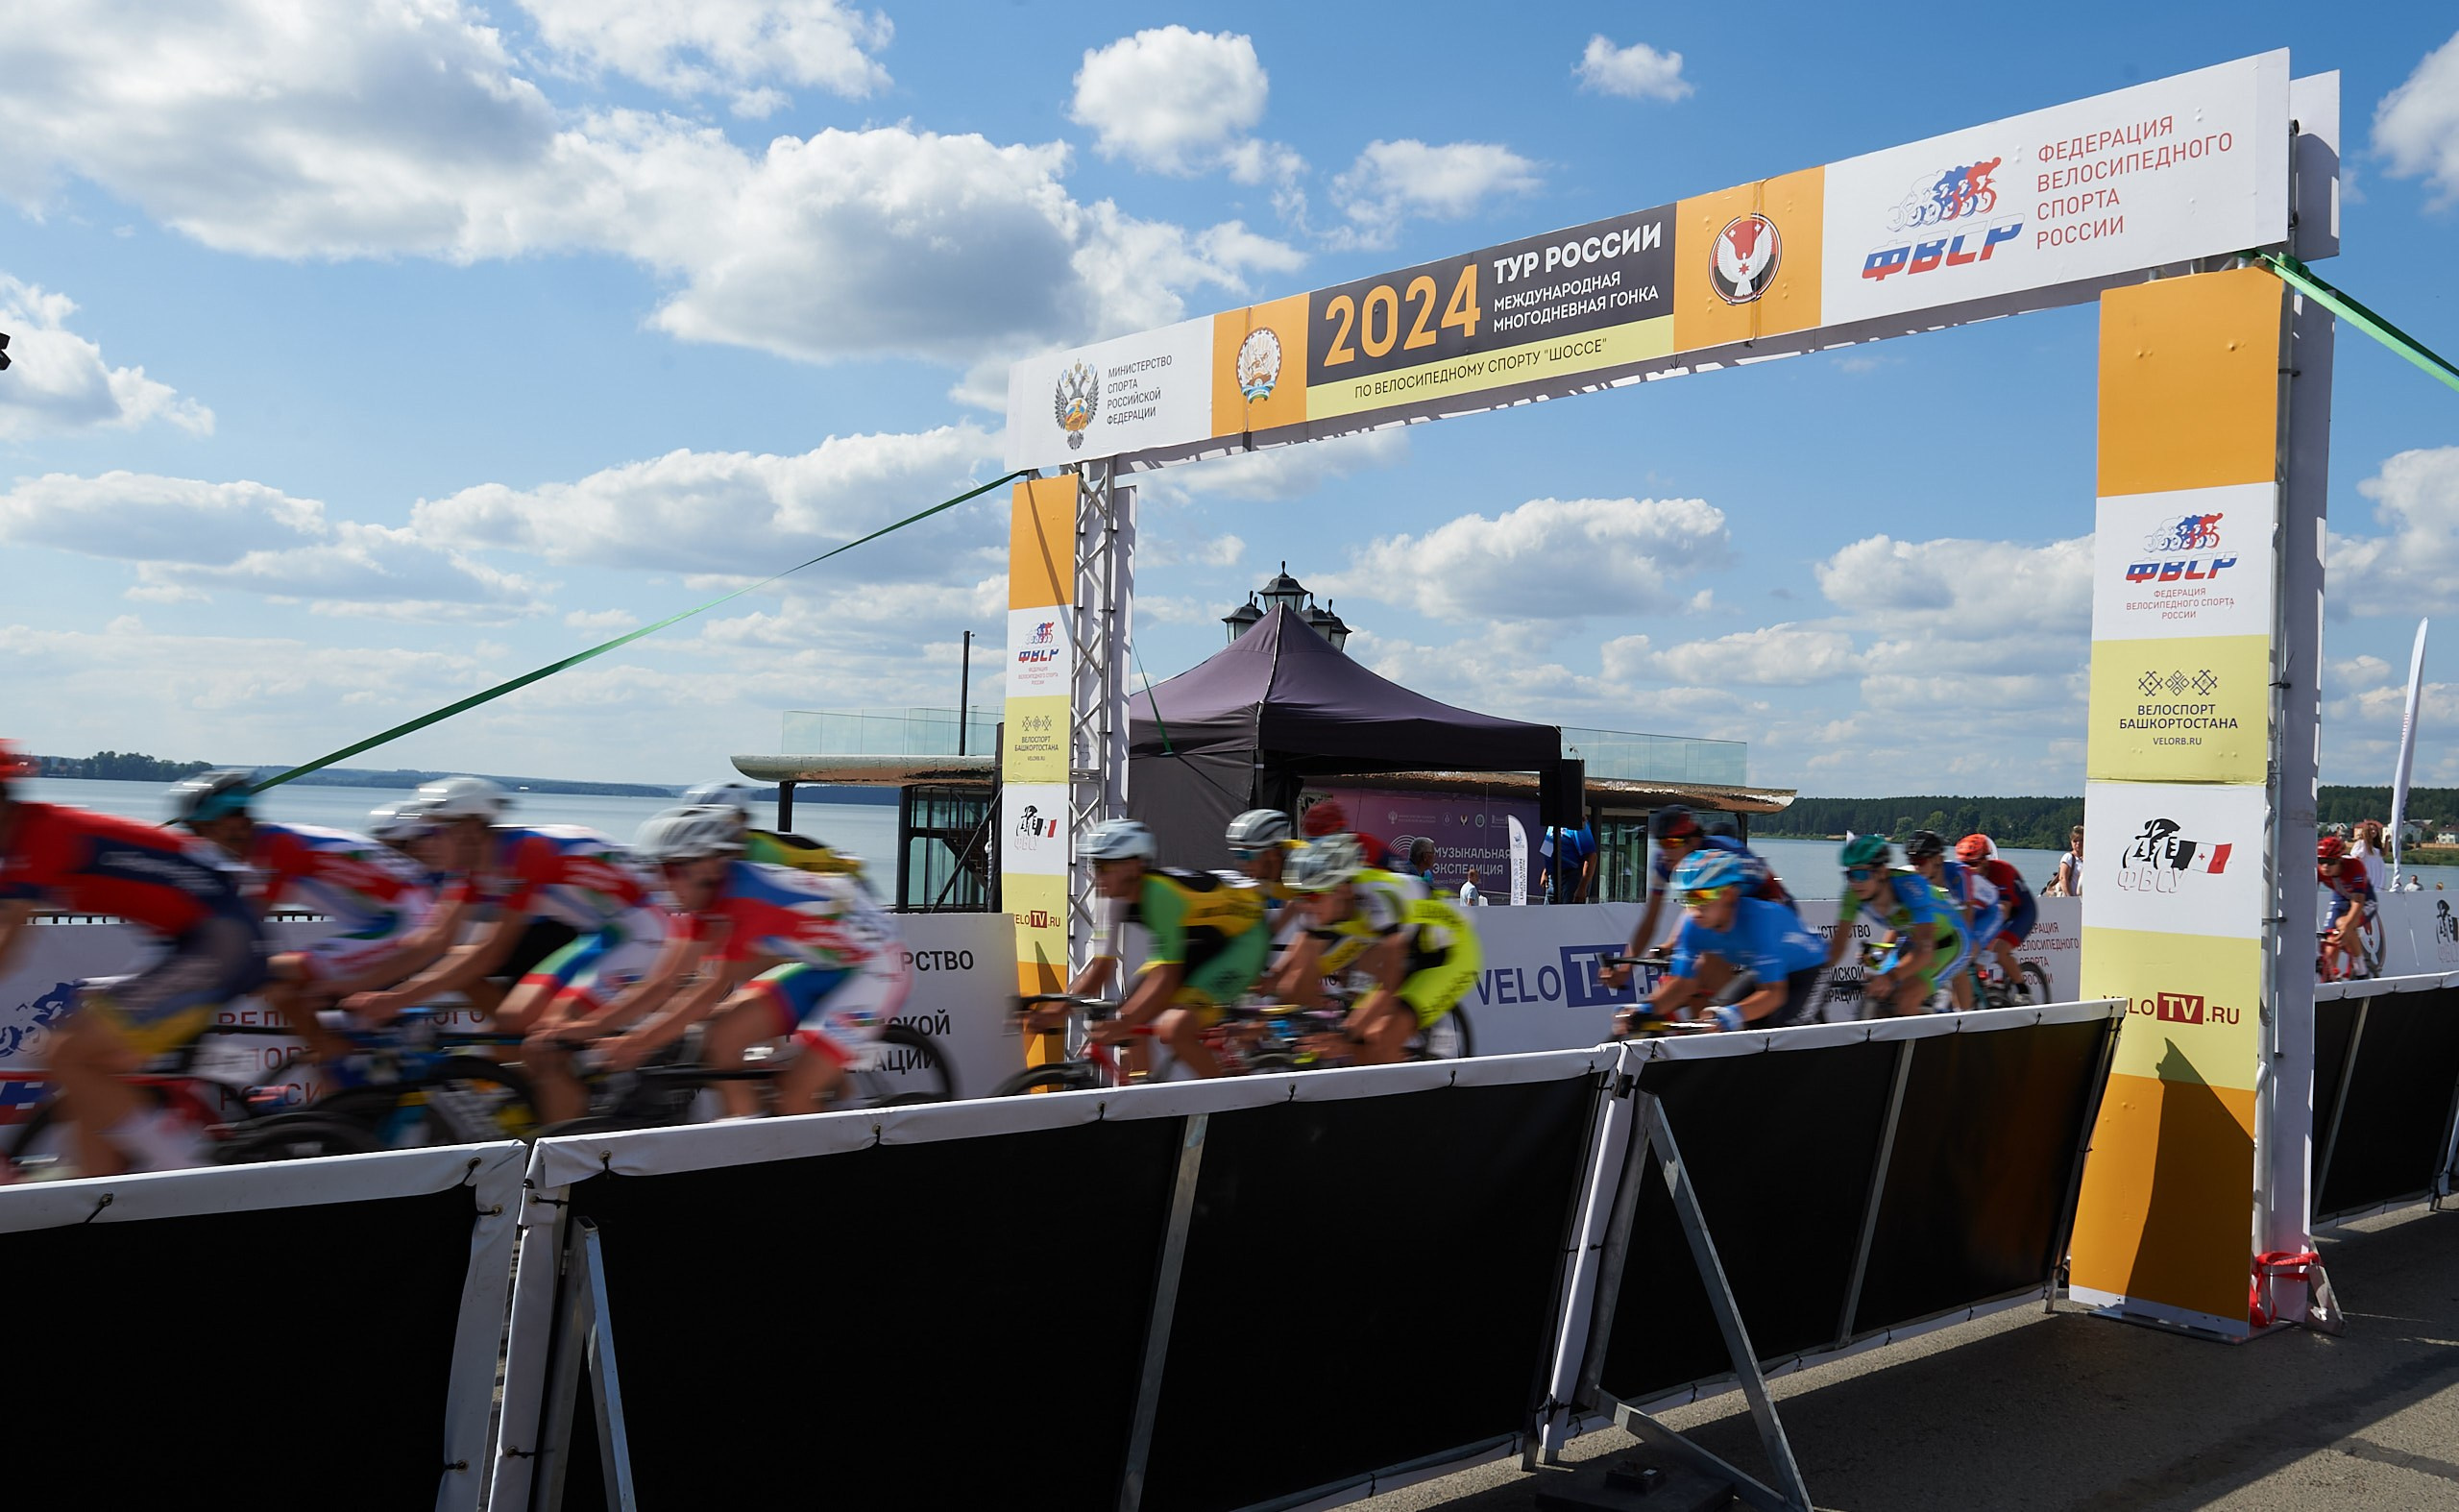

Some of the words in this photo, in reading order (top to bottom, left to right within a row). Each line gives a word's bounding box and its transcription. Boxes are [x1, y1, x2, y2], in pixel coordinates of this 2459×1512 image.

[2037, 115, 2173, 163] ФЕДЕРАЦИЯ
[2036, 132, 2233, 193] ВЕЛОСИПЕДНОГО
[2036, 188, 2120, 221] СПОРТА
[2036, 215, 2124, 250] РОССИИ
[1494, 251, 1539, 284] ТУР
[1545, 222, 1662, 273] РОССИИ
[1494, 271, 1621, 313] МЕЖДУНАРОДНАЯ
[1324, 263, 1481, 367] 2024
[1494, 295, 1606, 333] МНОГОДНЕВНАЯ
[1609, 285, 1659, 309] ГОНКА
[1108, 354, 1173, 378] МИНИСТЕРСТВО
[1354, 380, 1373, 399] ПО
[1375, 361, 1485, 396] ВЕЛОСИПЕДНОМУ
[1488, 352, 1542, 379] СПОРТУ
[1544, 337, 1608, 362] "ШОССЕ"
[1108, 378, 1138, 395] СПОРТА
[1107, 389, 1161, 410] РОССИЙСКОЙ
[1107, 406, 1156, 426] ФЕДЕРАЦИИ
[2154, 587, 2206, 598] ФЕДЕРАЦИЯ
[2126, 598, 2200, 611] ВЕЛОСИПЕДНОГО
[2201, 597, 2235, 606] СПОРТА
[2161, 610, 2197, 620] РОССИИ
[2137, 703, 2217, 718] ВЕЛОСПОРТ
[2119, 717, 2239, 730] БАШКОРТОСТАНА
[1014, 744, 1059, 752] БАШКОРТОСТАНА
[1022, 735, 1051, 744] ВЕЛОСПОРТ
[2153, 736, 2203, 746] VELORB.RU
[1434, 846, 1511, 860] МУЗЫКАЛЬНАЯ
[1015, 910, 1061, 929] ELOTV.RU
